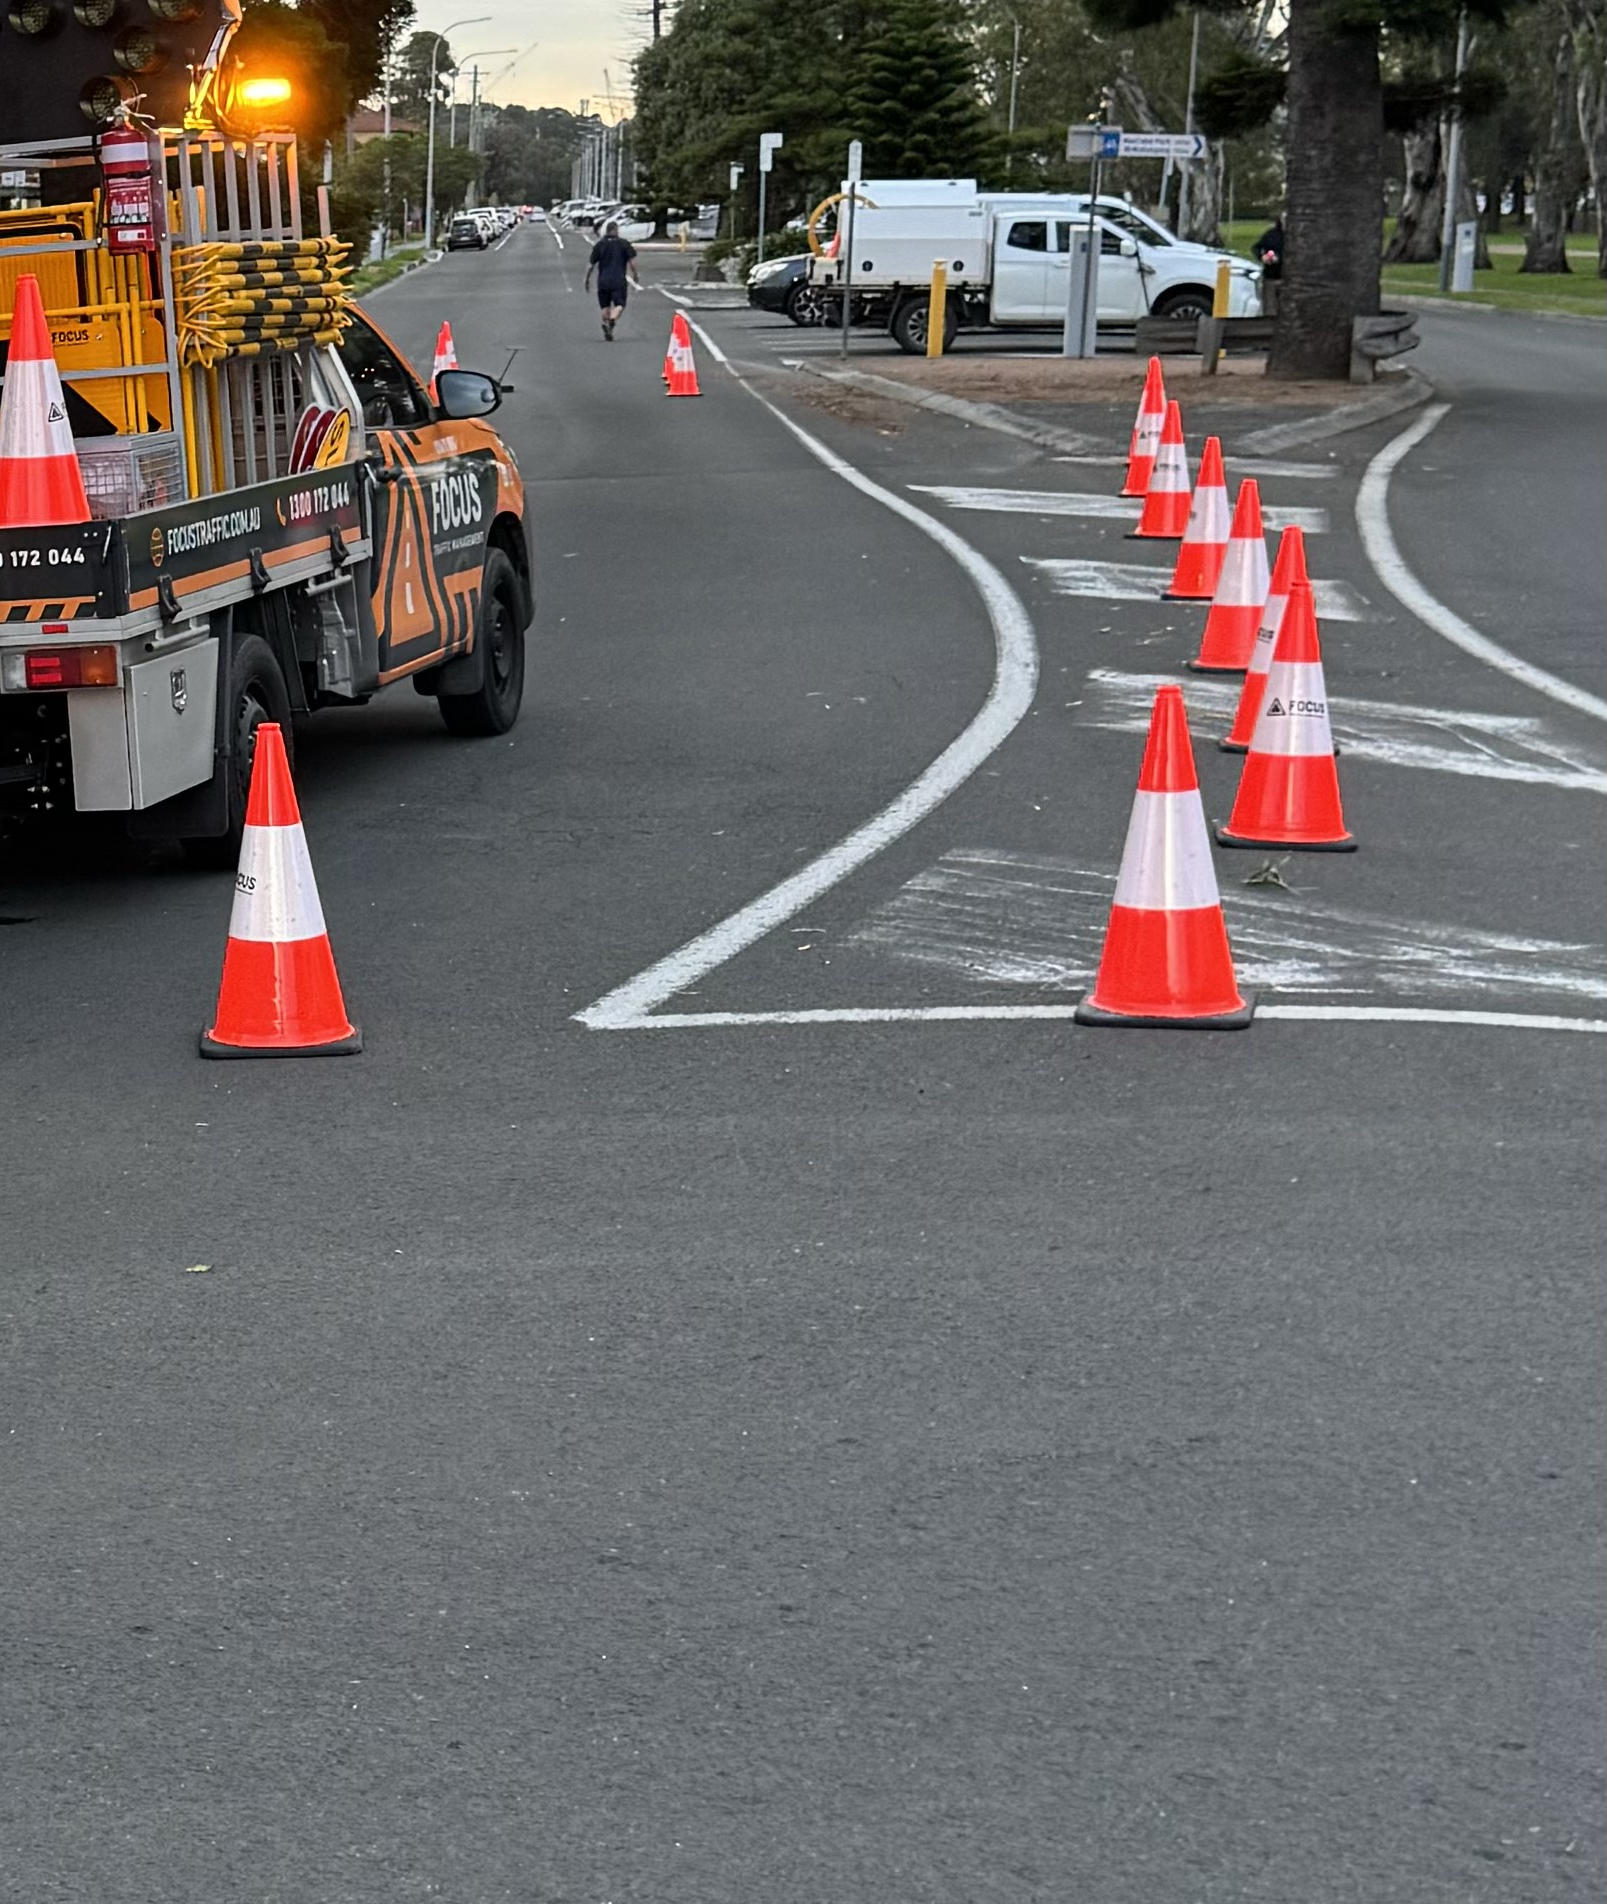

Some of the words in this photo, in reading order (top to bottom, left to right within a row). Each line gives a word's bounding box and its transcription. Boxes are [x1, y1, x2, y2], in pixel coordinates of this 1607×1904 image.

[52, 329, 89, 343] FOCUS
[289, 490, 312, 521] 1300
[314, 486, 329, 514] 172
[331, 481, 350, 509] 044
[430, 472, 482, 535] FOCUS
[167, 506, 261, 556] FOCUSTRAFFIC.COM.AU
[10, 549, 41, 567] 172
[48, 547, 85, 565] 044
[1288, 700, 1325, 714] FOCUS
